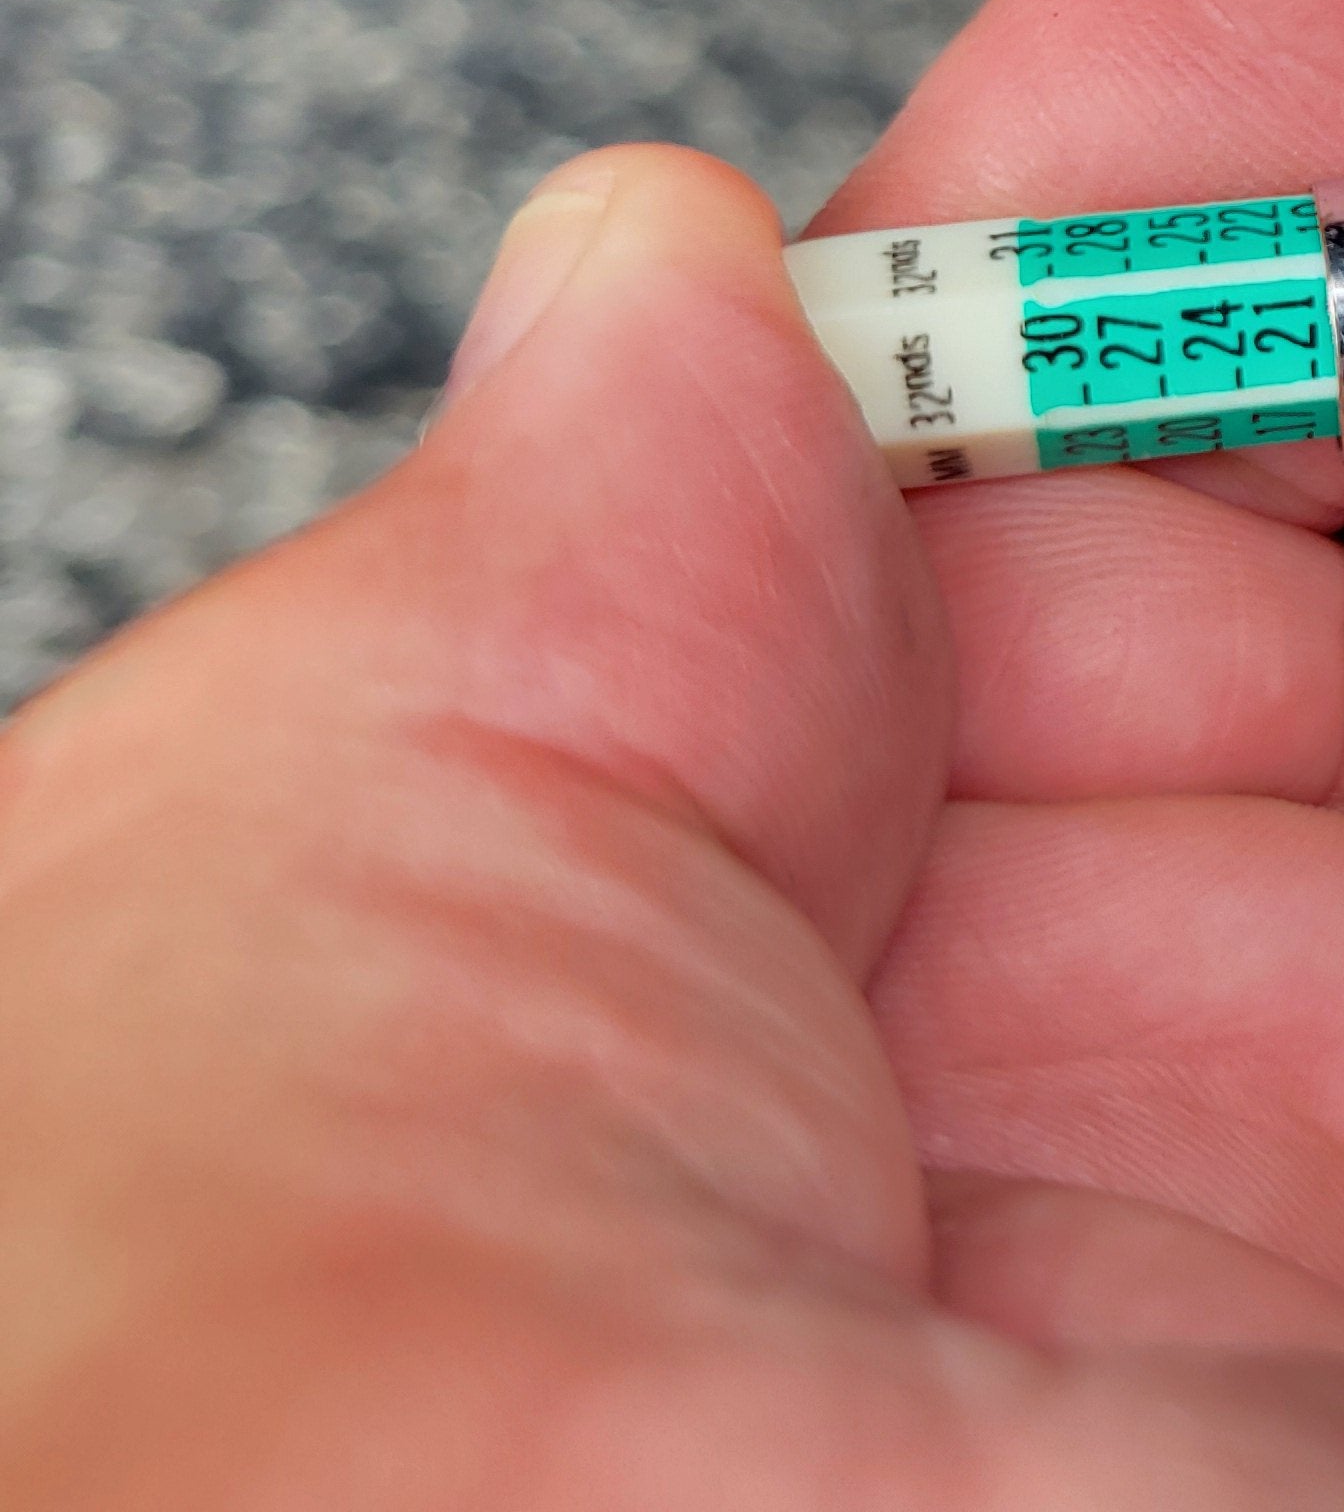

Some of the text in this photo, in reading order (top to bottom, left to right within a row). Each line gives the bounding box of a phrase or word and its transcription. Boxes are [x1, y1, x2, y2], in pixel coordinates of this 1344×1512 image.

[1065, 219, 1129, 256] 28
[1148, 211, 1211, 248] 25
[1218, 204, 1282, 241] 22
[882, 239, 938, 298] 32nds
[1021, 314, 1088, 373] 30
[1096, 315, 1164, 370] 27
[1180, 299, 1245, 361] 24
[1252, 296, 1317, 353] 21
[895, 334, 956, 428] 32nds
[1063, 426, 1129, 455] 23
[1157, 417, 1222, 445] 20
